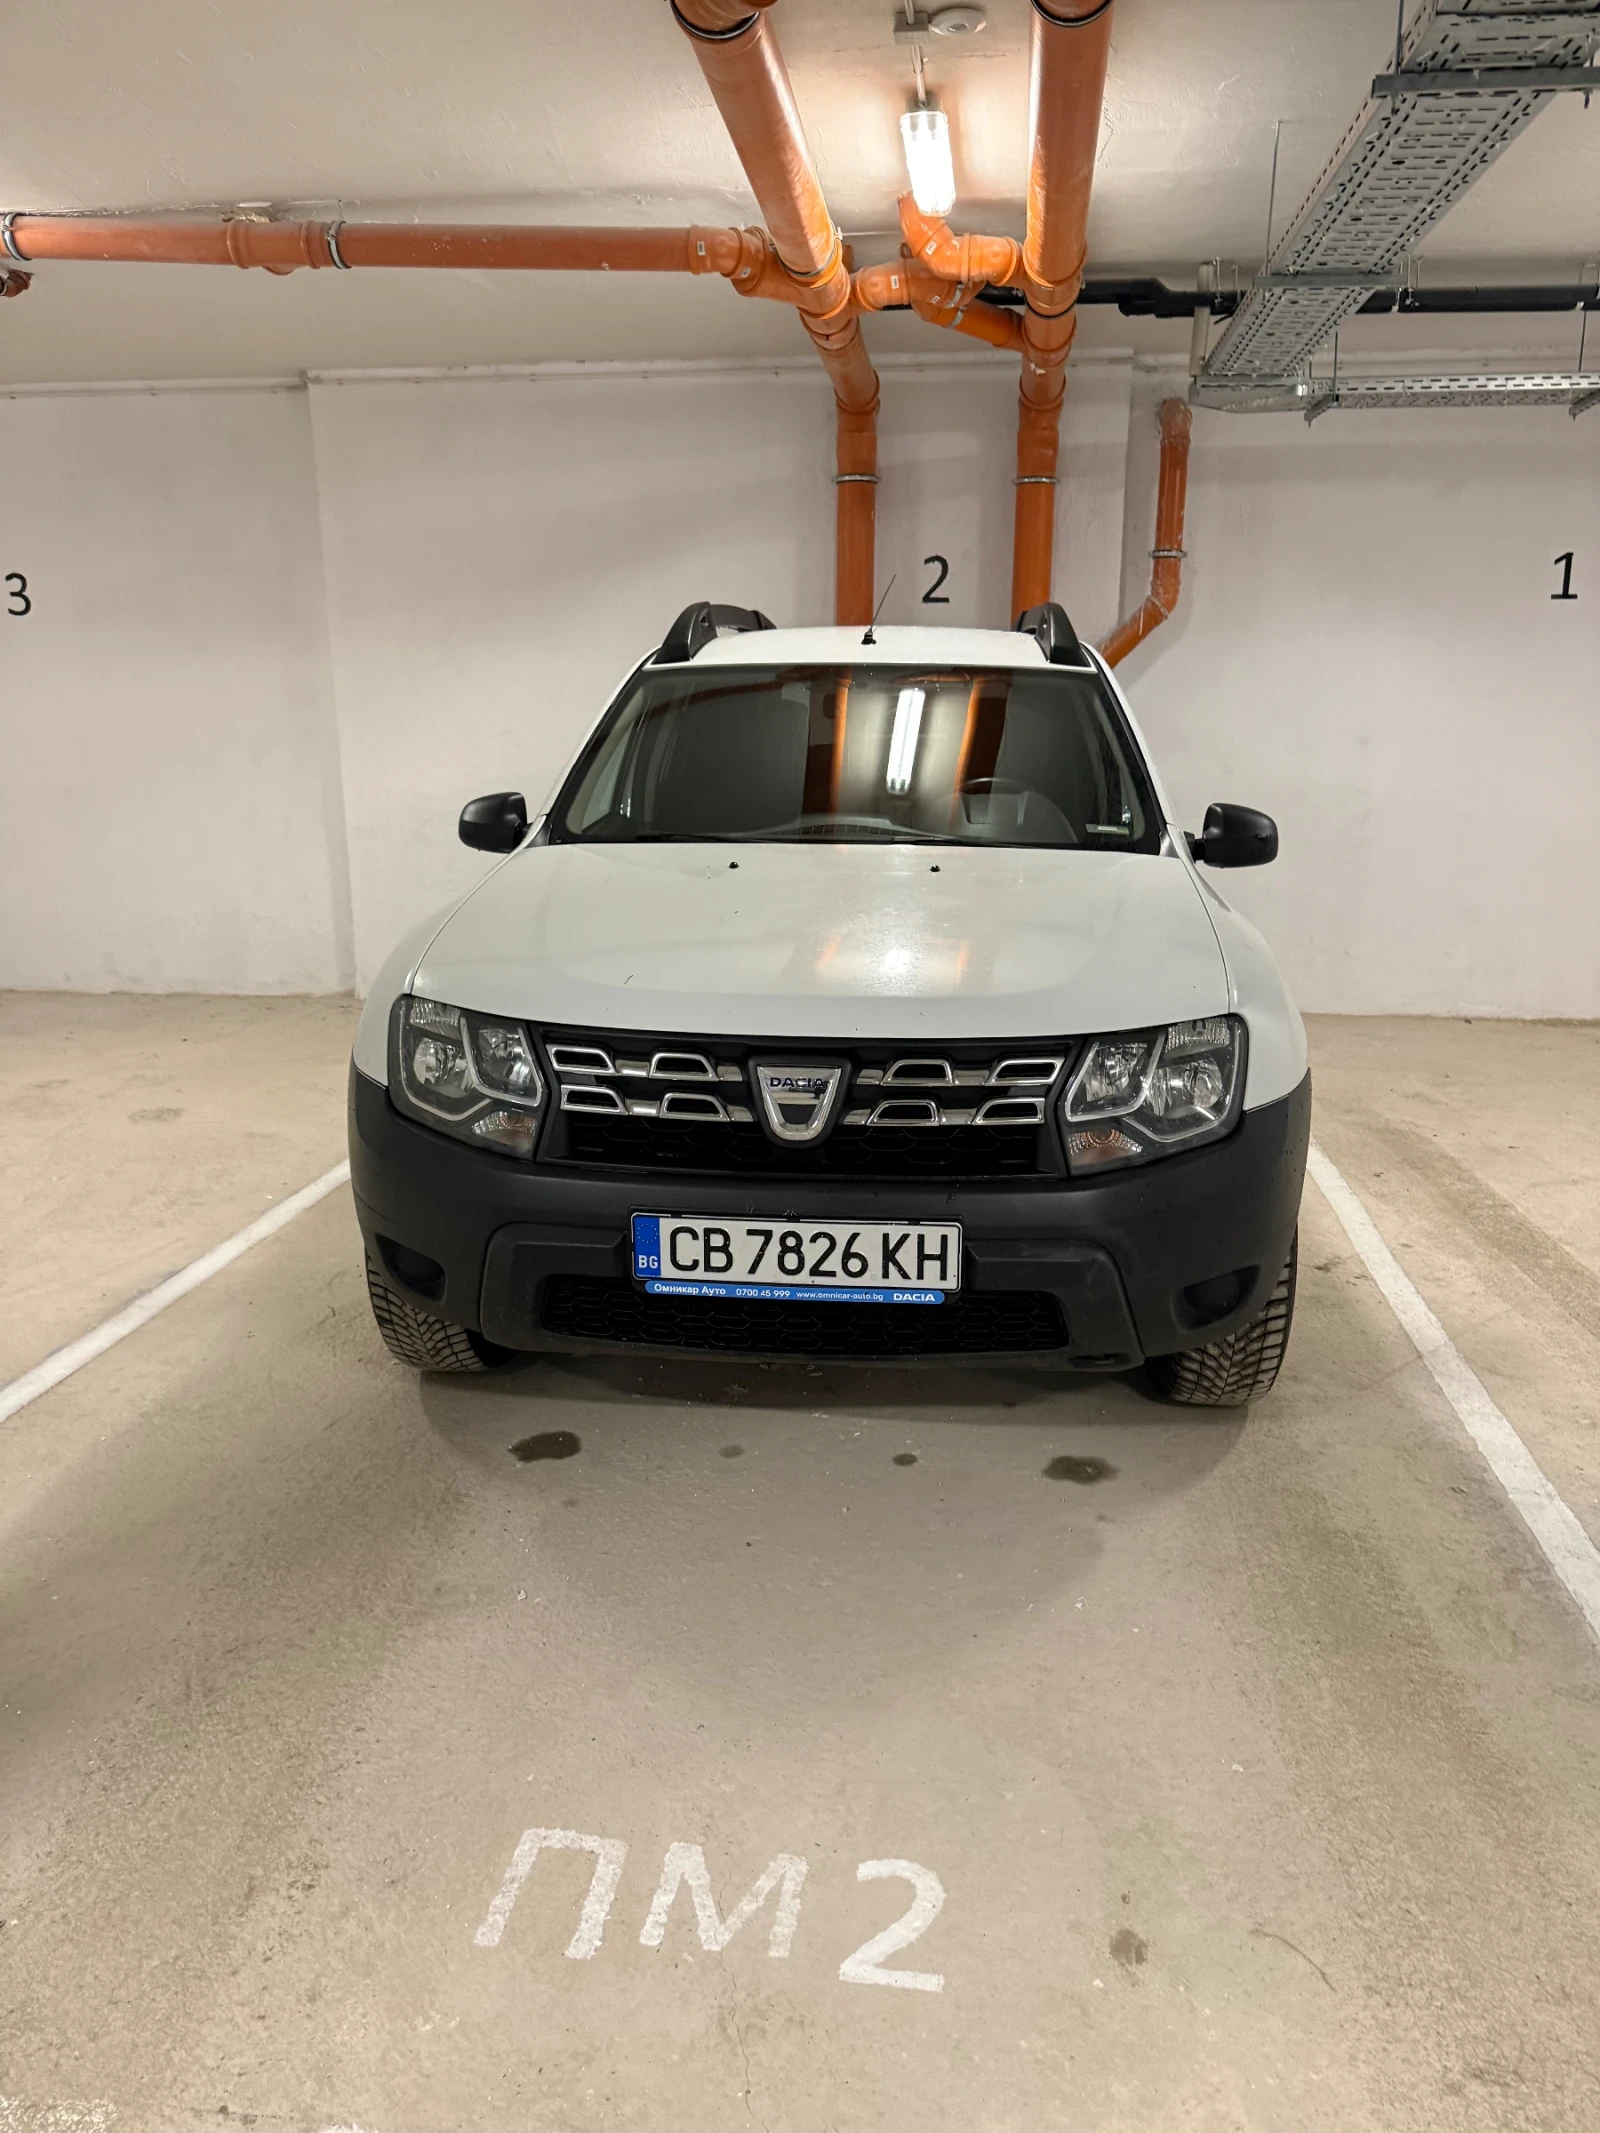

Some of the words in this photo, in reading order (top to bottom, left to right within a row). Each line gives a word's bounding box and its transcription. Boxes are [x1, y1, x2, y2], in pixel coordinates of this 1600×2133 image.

[5, 572, 31, 617] 3
[922, 555, 950, 604] 2
[1550, 552, 1578, 600] 1
[770, 1077, 824, 1088] DACIA
[638, 1254, 659, 1269] BG
[746, 1229, 869, 1278] 7826
[654, 1283, 699, 1295] Омникар
[701, 1286, 726, 1296] Ауто
[735, 1288, 758, 1297] 0700
[760, 1289, 771, 1297] 45
[773, 1290, 790, 1298] 999
[893, 1293, 936, 1302] DACIA
[838, 1858, 947, 1993] 2
